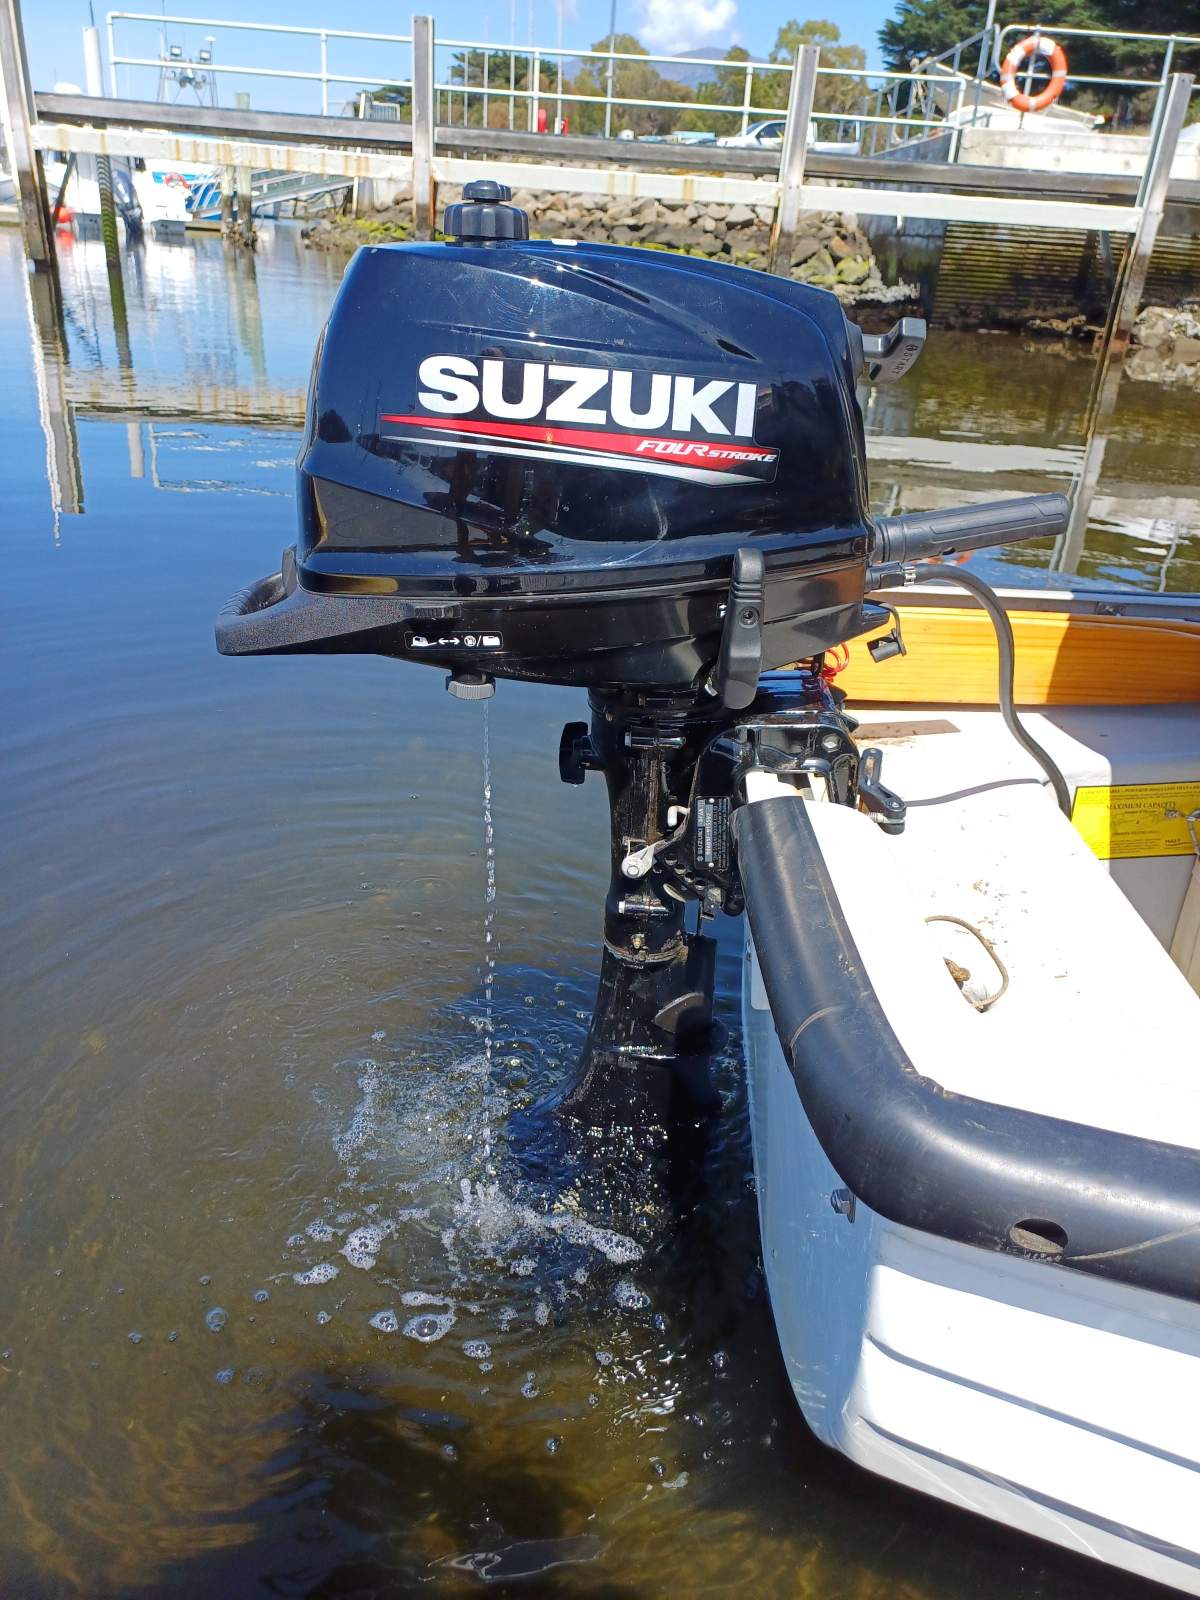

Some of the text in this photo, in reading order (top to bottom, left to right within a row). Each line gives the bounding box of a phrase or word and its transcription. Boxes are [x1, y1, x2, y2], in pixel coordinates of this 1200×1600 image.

[418, 355, 757, 438] SUZUKI
[636, 440, 776, 462] FOUR STROKE
